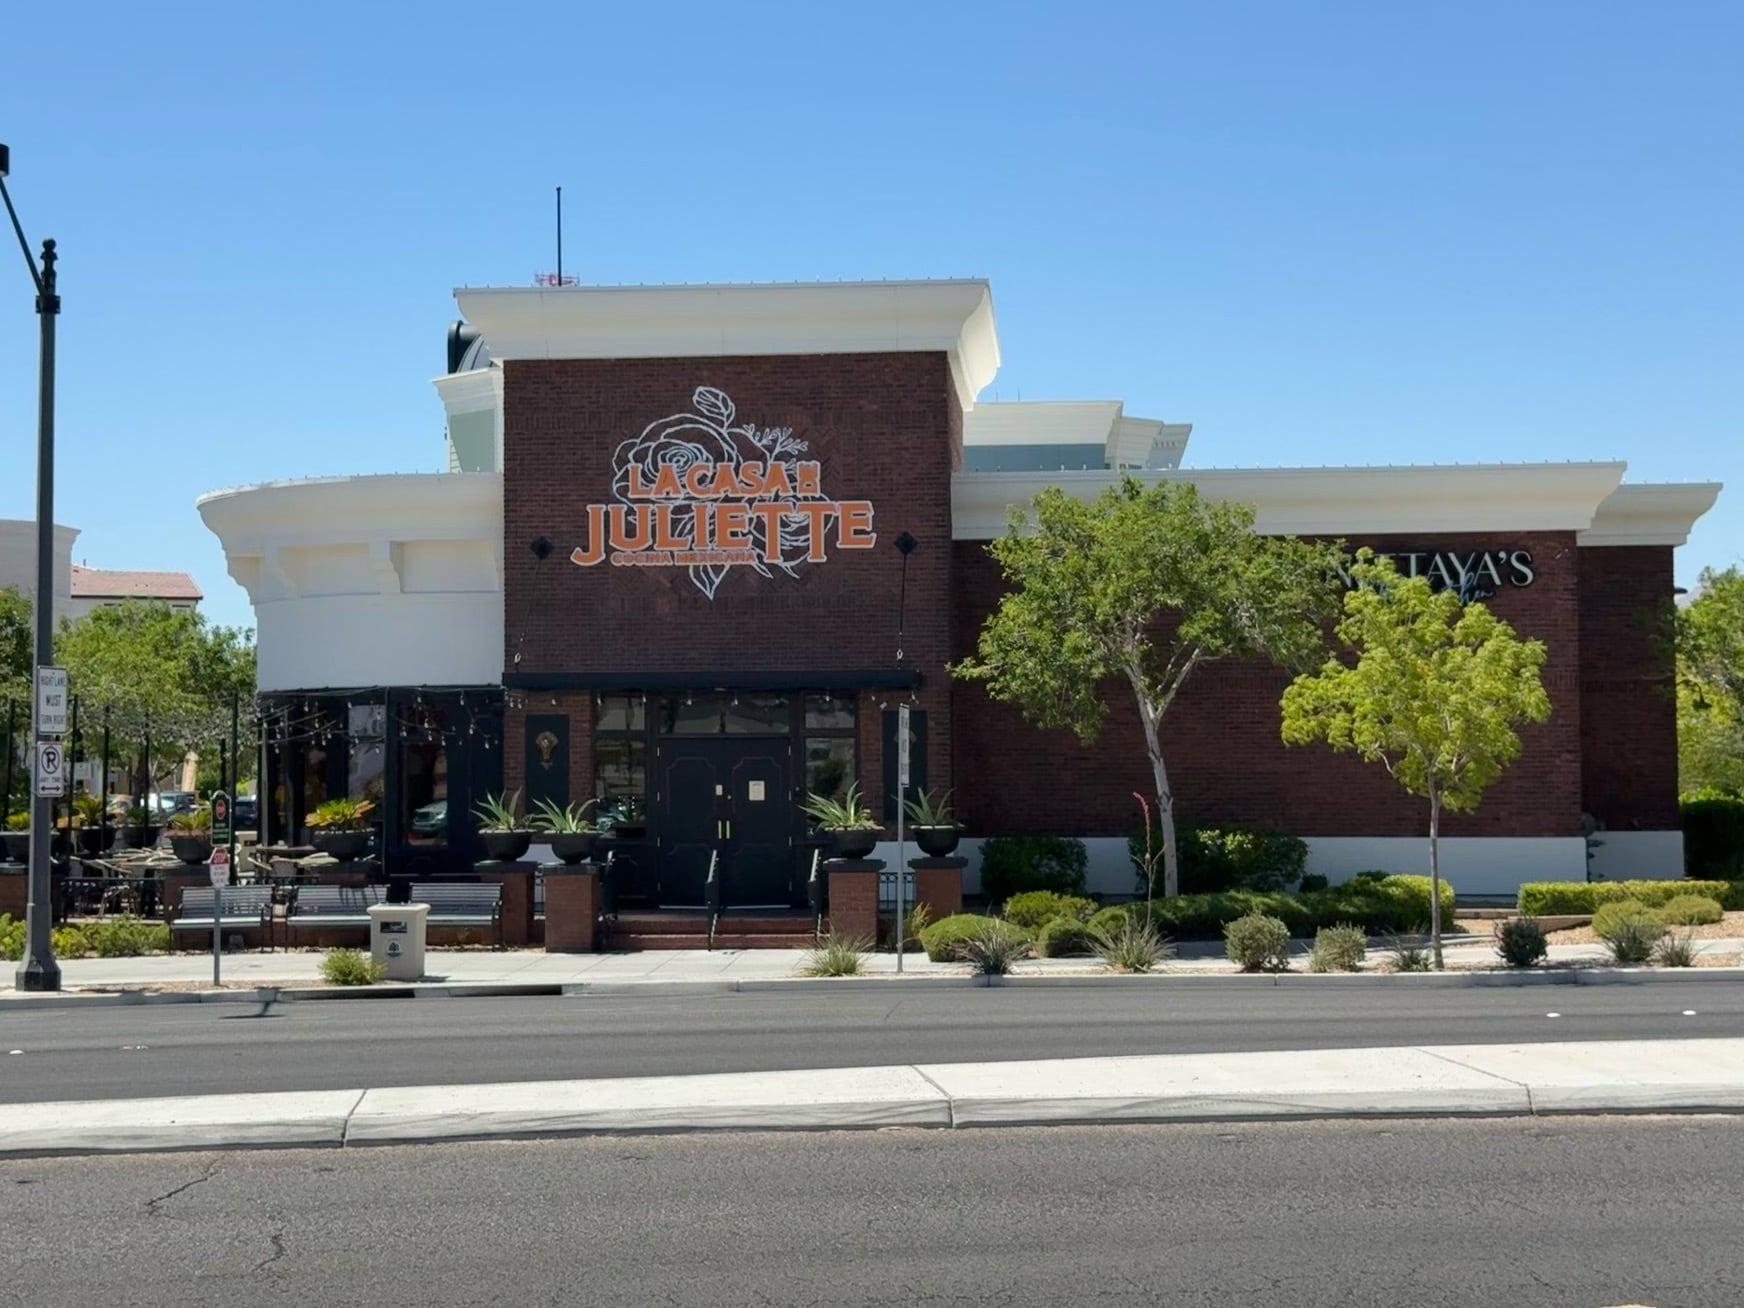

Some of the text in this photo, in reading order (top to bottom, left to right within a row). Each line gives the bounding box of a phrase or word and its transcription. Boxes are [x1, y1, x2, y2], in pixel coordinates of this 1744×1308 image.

[627, 462, 682, 498] LA
[684, 461, 793, 498] CASA
[570, 500, 877, 567] JULIETTE
[46, 694, 61, 707] MUST
